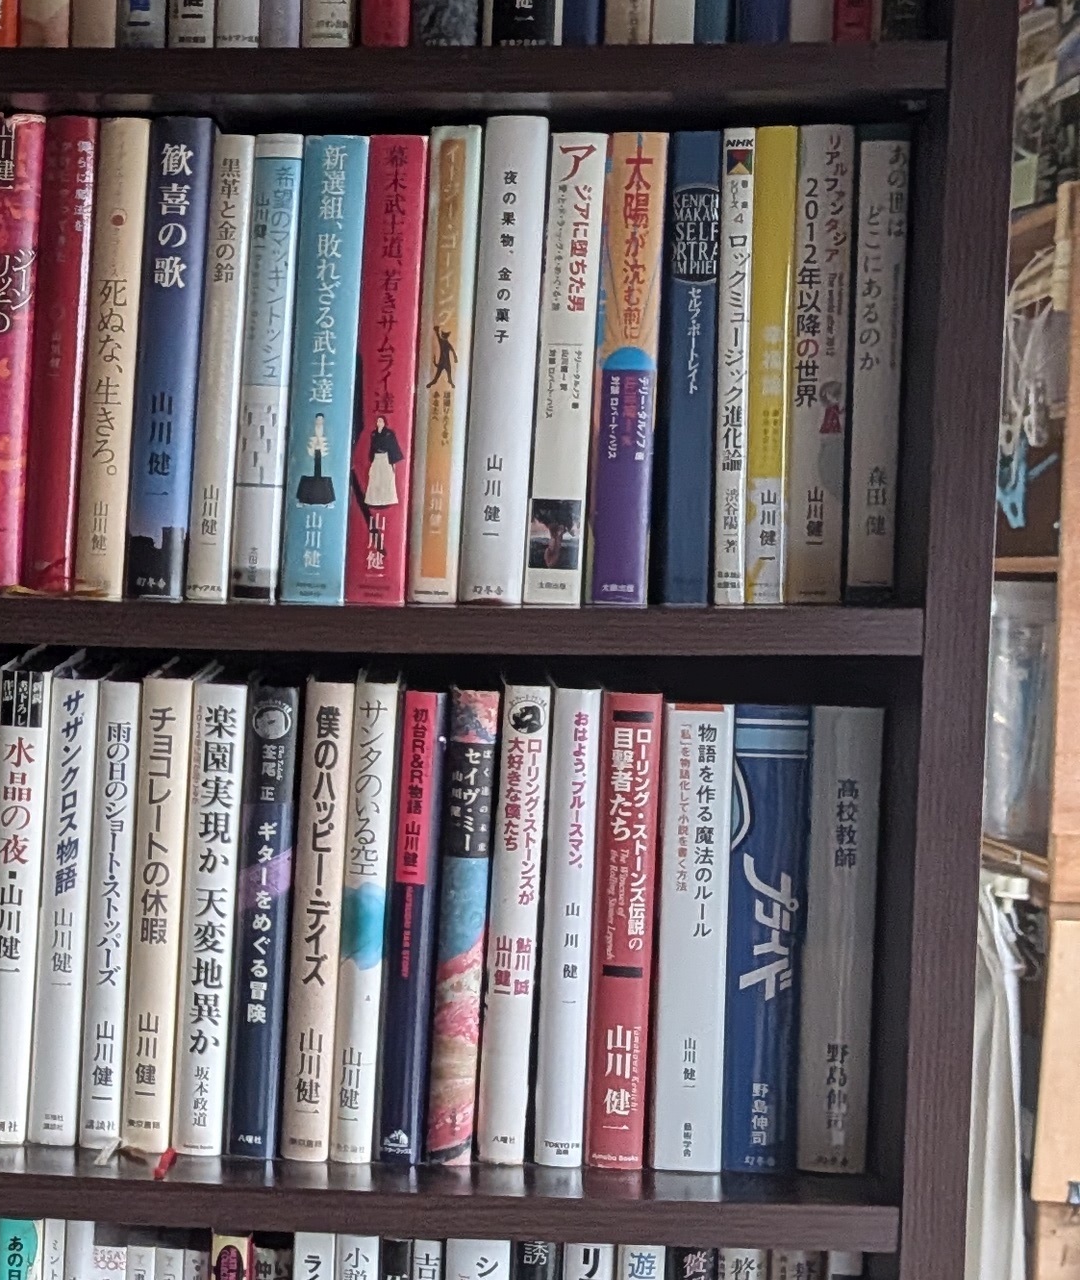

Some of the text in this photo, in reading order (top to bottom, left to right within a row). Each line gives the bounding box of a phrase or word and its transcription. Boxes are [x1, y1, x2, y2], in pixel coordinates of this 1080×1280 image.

[153, 144, 193, 289] 歓喜の歌
[212, 157, 240, 284] 黒革と金の鈴
[726, 138, 754, 147] NHK
[309, 144, 348, 404] 新選組、敗れざる武士達
[493, 169, 518, 344] 夜の果物、金の菓子
[795, 178, 821, 409] 2012年以降の世界
[92, 279, 127, 476] 死ぬな、生きろ。
[722, 234, 750, 472] ロックミュージック進化論
[483, 454, 503, 537] 山川健一
[759, 490, 777, 561] 山川健一
[55, 691, 86, 897] サザンクロス物語
[95, 721, 131, 988] 雨の日のショート・ストッパーズ
[139, 705, 176, 944] チョコレートの休暇
[198, 705, 237, 874] 楽園実現か
[302, 704, 341, 986] 僕のハッピー・デイズ
[347, 700, 388, 877] サンタのいる空
[627, 728, 653, 951] ローリング・ストーンズ伝説の
[693, 724, 718, 938] 物語を作る魔法のルール
[834, 778, 859, 869] 高校教師
[189, 887, 229, 1055] 天変地異か
[739, 852, 798, 1002] プライド
[682, 1038, 697, 1089] 山川健一
